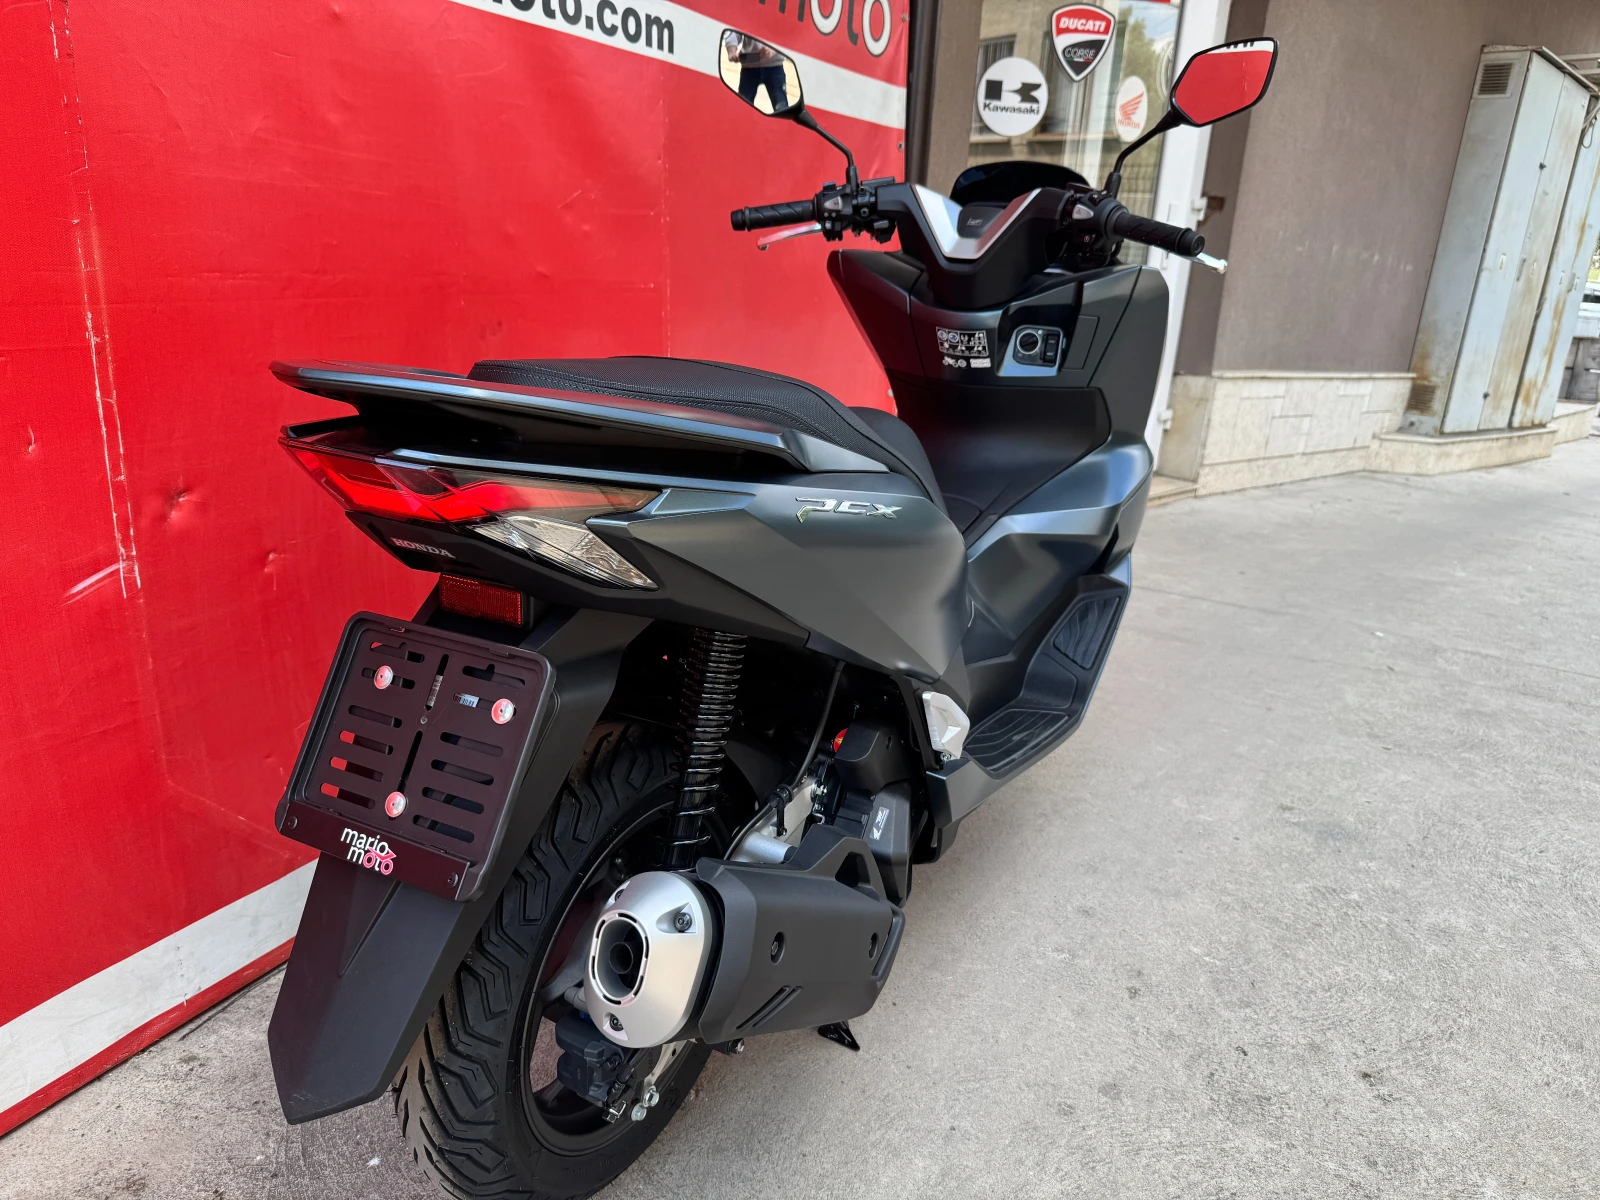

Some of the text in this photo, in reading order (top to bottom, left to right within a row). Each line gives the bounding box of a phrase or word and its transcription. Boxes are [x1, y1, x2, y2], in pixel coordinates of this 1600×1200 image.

[1059, 17, 1106, 32] DUCATI
[1064, 47, 1096, 59] CORSE
[982, 101, 1040, 116] Kawasaki
[1117, 119, 1141, 129] HONDA
[795, 496, 902, 523] PCX
[390, 537, 457, 559] HONDA
[340, 827, 389, 856] mario
[346, 846, 394, 875] moto
